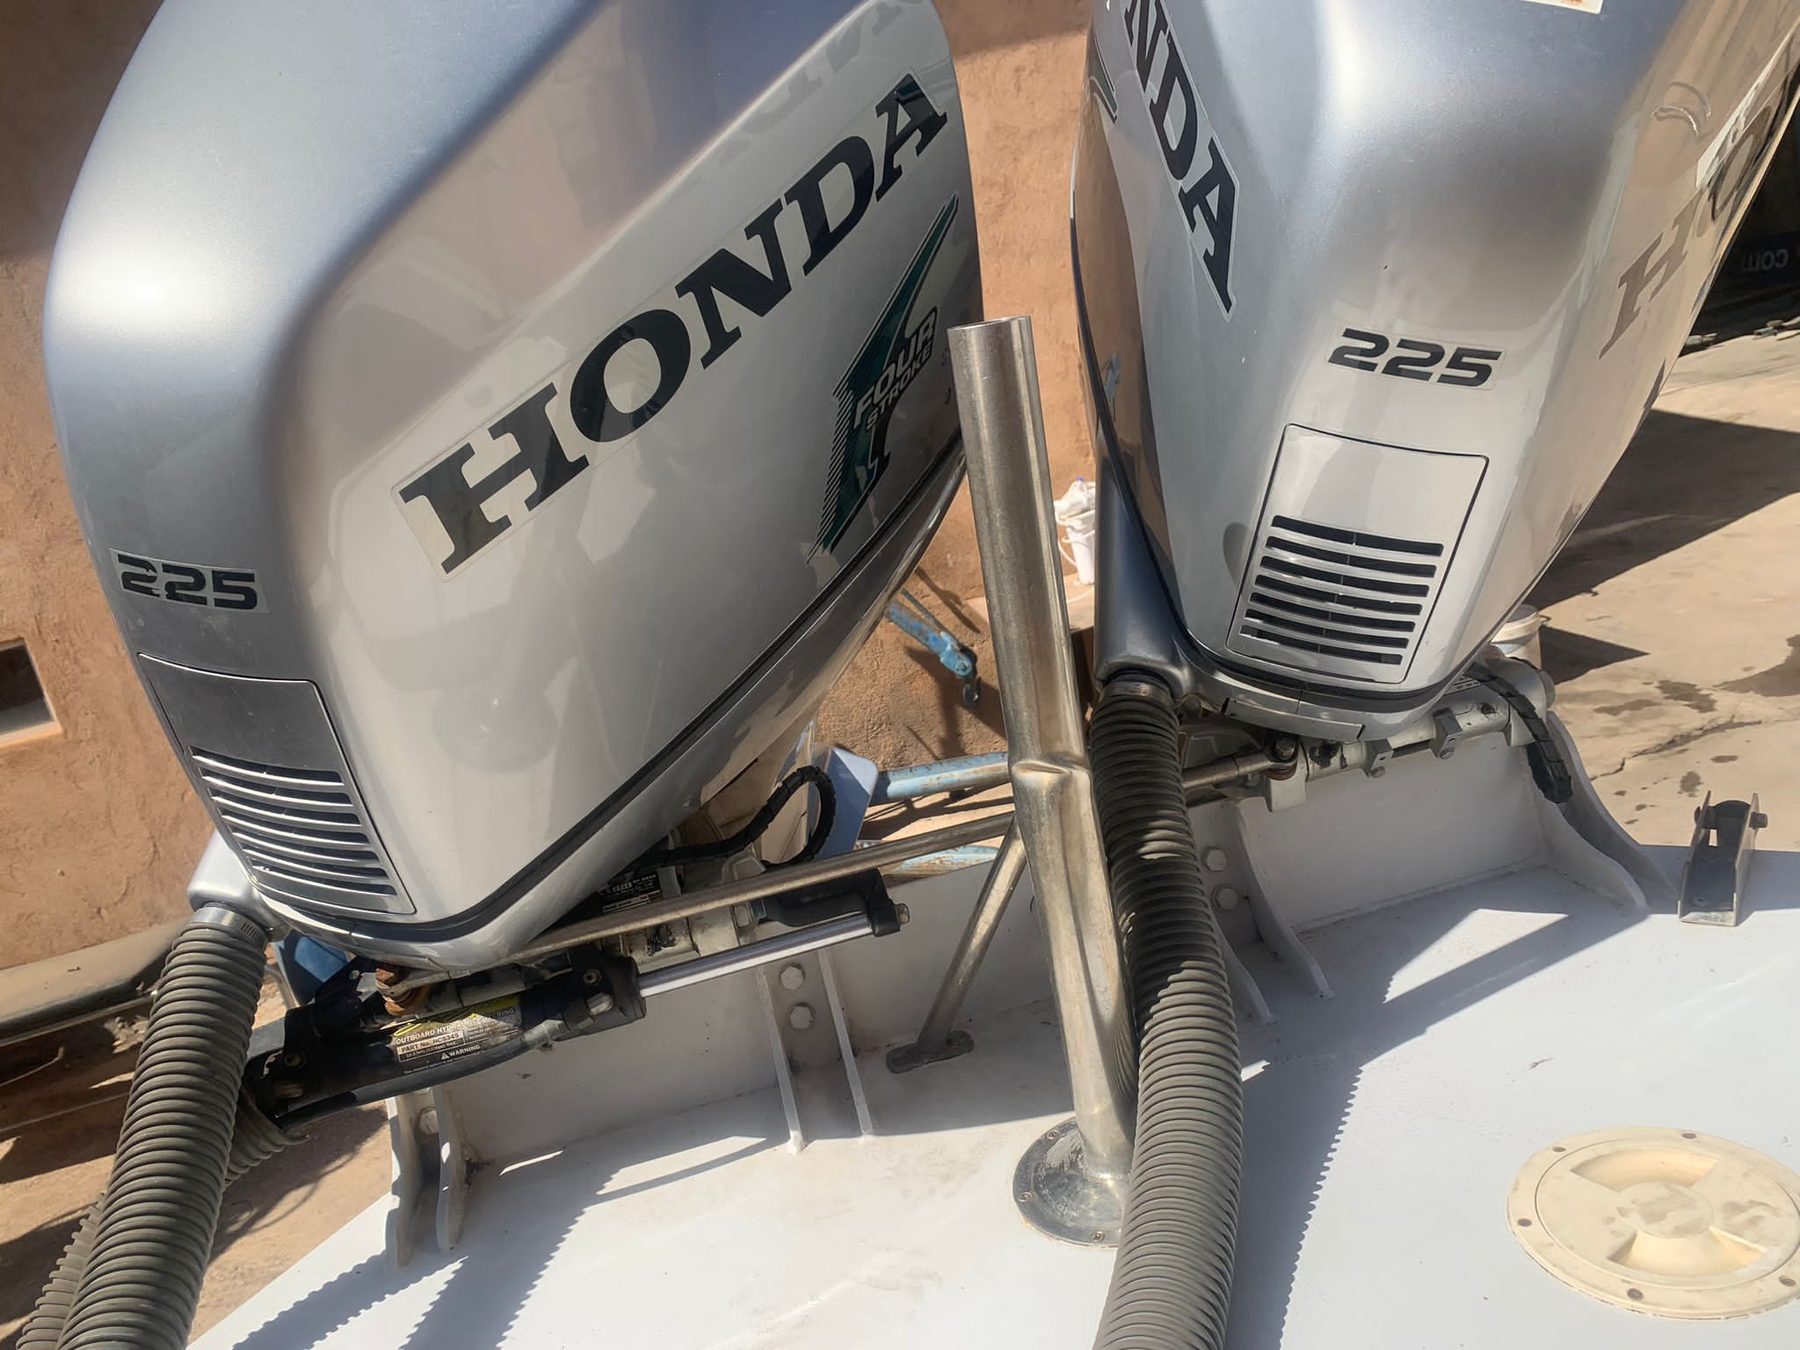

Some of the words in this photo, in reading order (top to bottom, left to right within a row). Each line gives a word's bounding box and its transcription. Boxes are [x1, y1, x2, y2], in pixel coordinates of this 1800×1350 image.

[399, 73, 948, 574] HONDA
[853, 310, 937, 430] FOUR
[866, 340, 934, 431] STROKE
[1328, 328, 1503, 388] 225
[117, 553, 258, 610] 225
[395, 1029, 436, 1045] OUTBOARD
[401, 1043, 419, 1053] PART
[449, 1044, 481, 1057] WARNING
